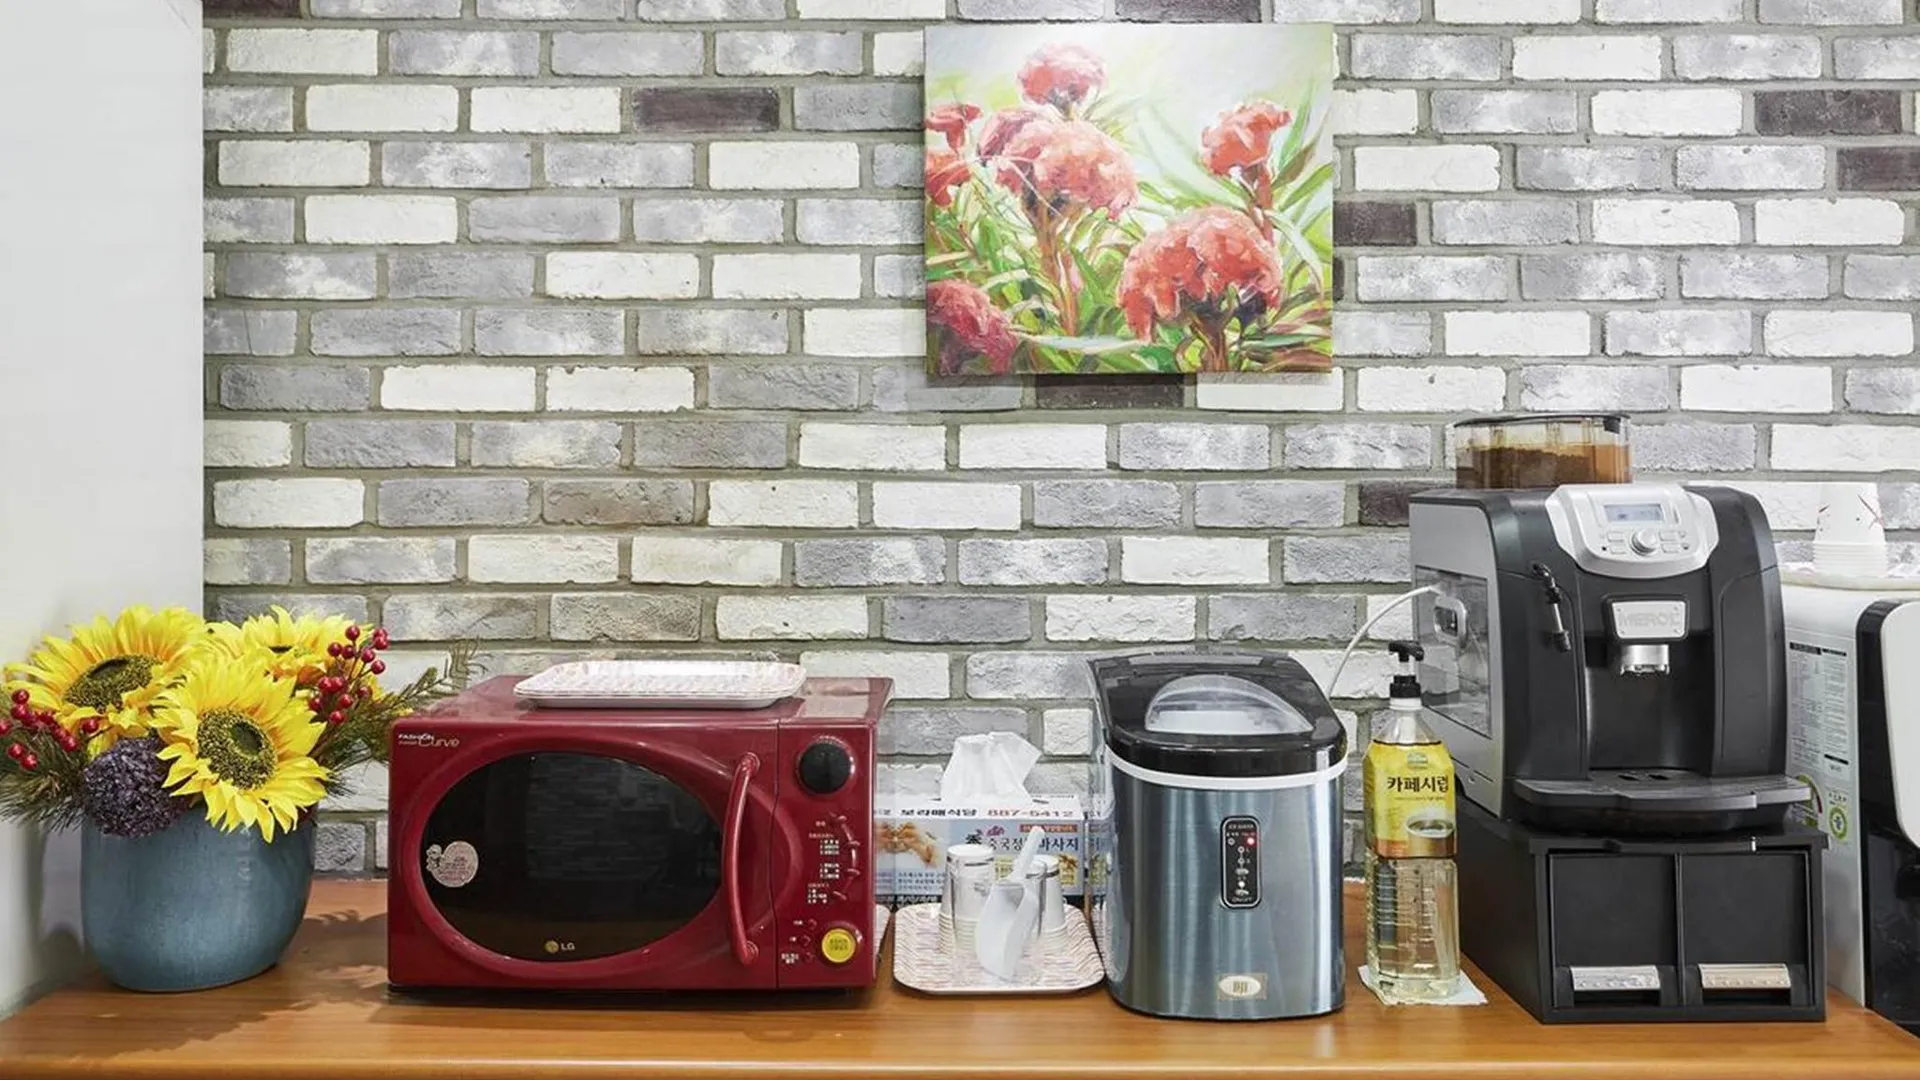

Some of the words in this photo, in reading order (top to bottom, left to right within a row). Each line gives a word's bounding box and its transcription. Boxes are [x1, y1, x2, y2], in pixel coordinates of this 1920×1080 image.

[1387, 775, 1449, 792] 카페시럽
[987, 809, 1074, 817] 887-5412
[988, 836, 1079, 852] 중국정마사지
[561, 942, 576, 951] LG
